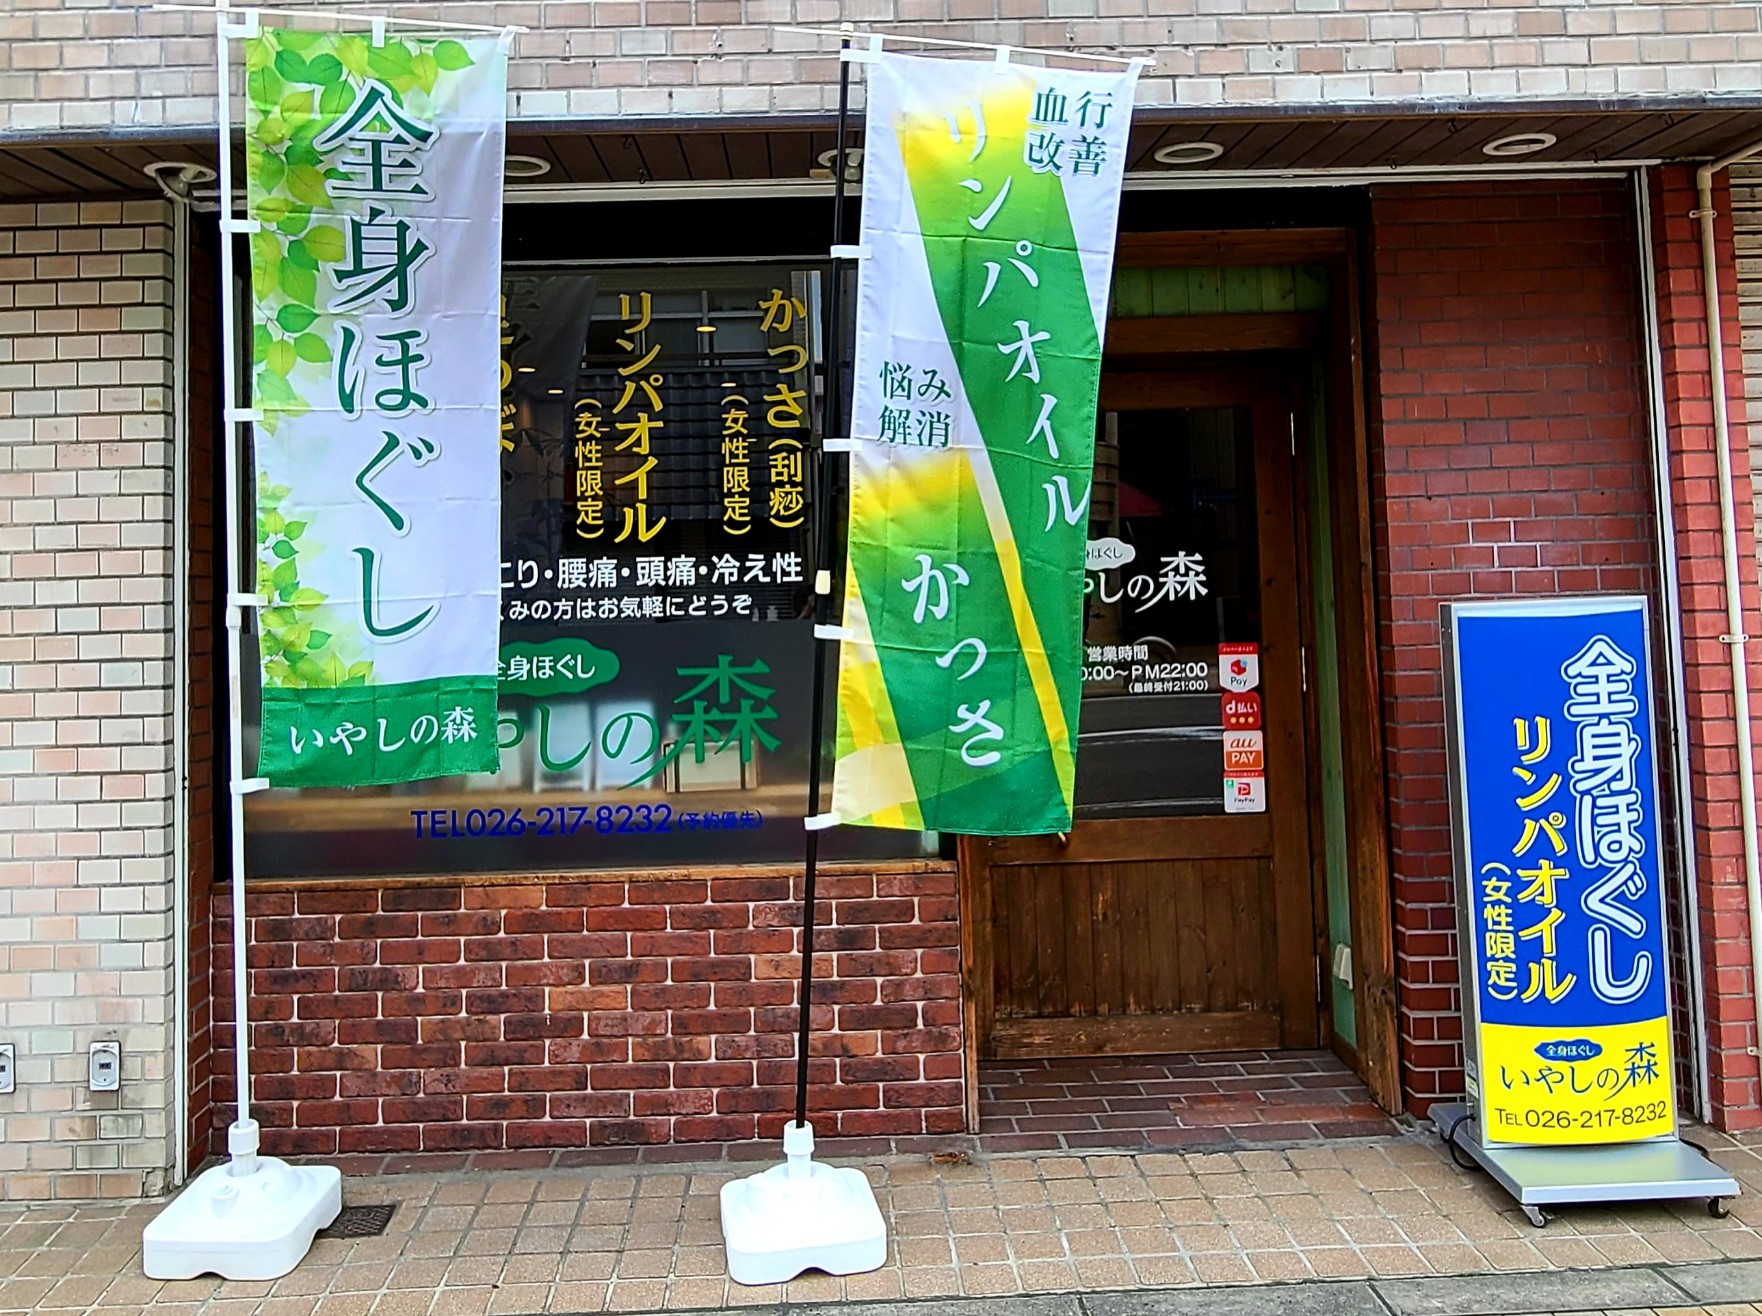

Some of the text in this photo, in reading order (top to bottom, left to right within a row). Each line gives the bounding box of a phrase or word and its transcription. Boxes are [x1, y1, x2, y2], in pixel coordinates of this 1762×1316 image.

[1031, 86, 1113, 129] 血行
[1027, 132, 1107, 176] 改善
[943, 100, 1091, 533] リンパオイル
[316, 84, 438, 639] 全身ほぐし
[879, 361, 951, 402] 悩み
[612, 291, 667, 543] リンパオイル
[877, 404, 950, 448] 解消
[574, 398, 604, 539] （女性限定）
[721, 394, 752, 536] （女性限定）
[901, 554, 1004, 767] かっさ
[1087, 644, 1149, 662] 営業時間
[1225, 699, 1258, 714] d払い
[1230, 676, 1248, 687] Pay
[290, 706, 478, 756] いやしの森
[1230, 738, 1257, 749] au
[1231, 752, 1256, 764] PAY
[1561, 635, 1652, 1004] 全身ほぐし
[1512, 716, 1577, 1003] リンパオイル
[1480, 862, 1518, 1001] （女性限定）
[1500, 1042, 1659, 1101] いやしの森
[1546, 1044, 1595, 1057] 全身ほぐし
